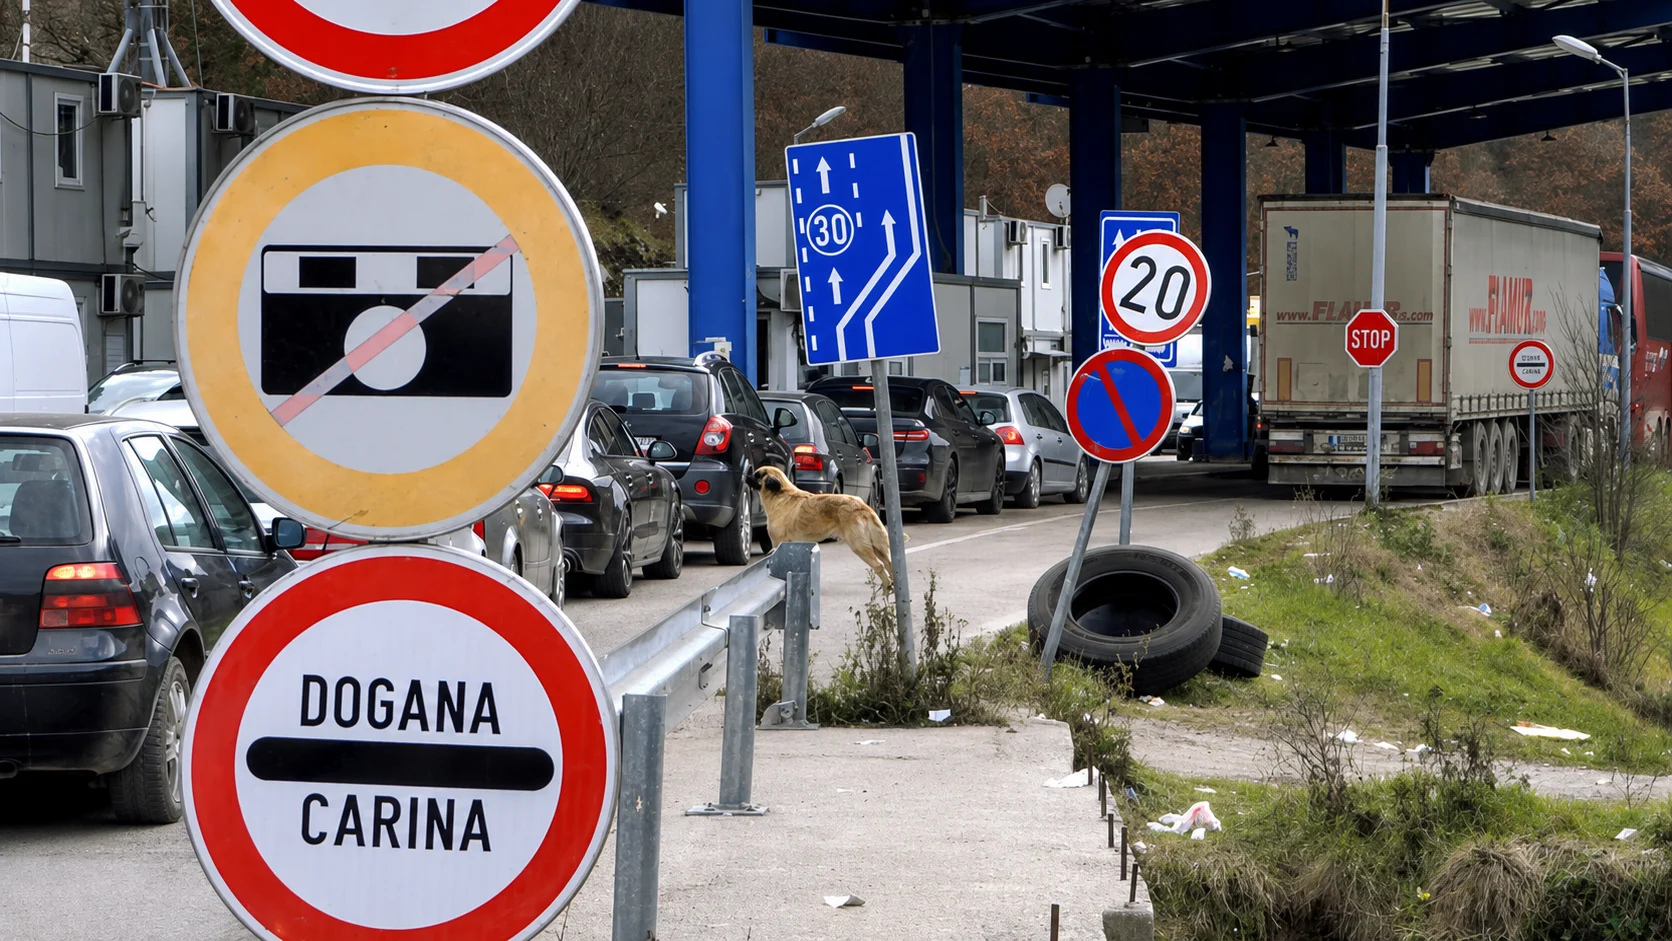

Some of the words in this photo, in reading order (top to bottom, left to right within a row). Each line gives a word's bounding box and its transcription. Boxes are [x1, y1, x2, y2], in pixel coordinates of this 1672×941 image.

[813, 213, 848, 247] 30
[1119, 255, 1191, 321] 20
[1351, 329, 1391, 349] STOP
[300, 674, 501, 735] DOGANA
[301, 792, 492, 852] CARINA
